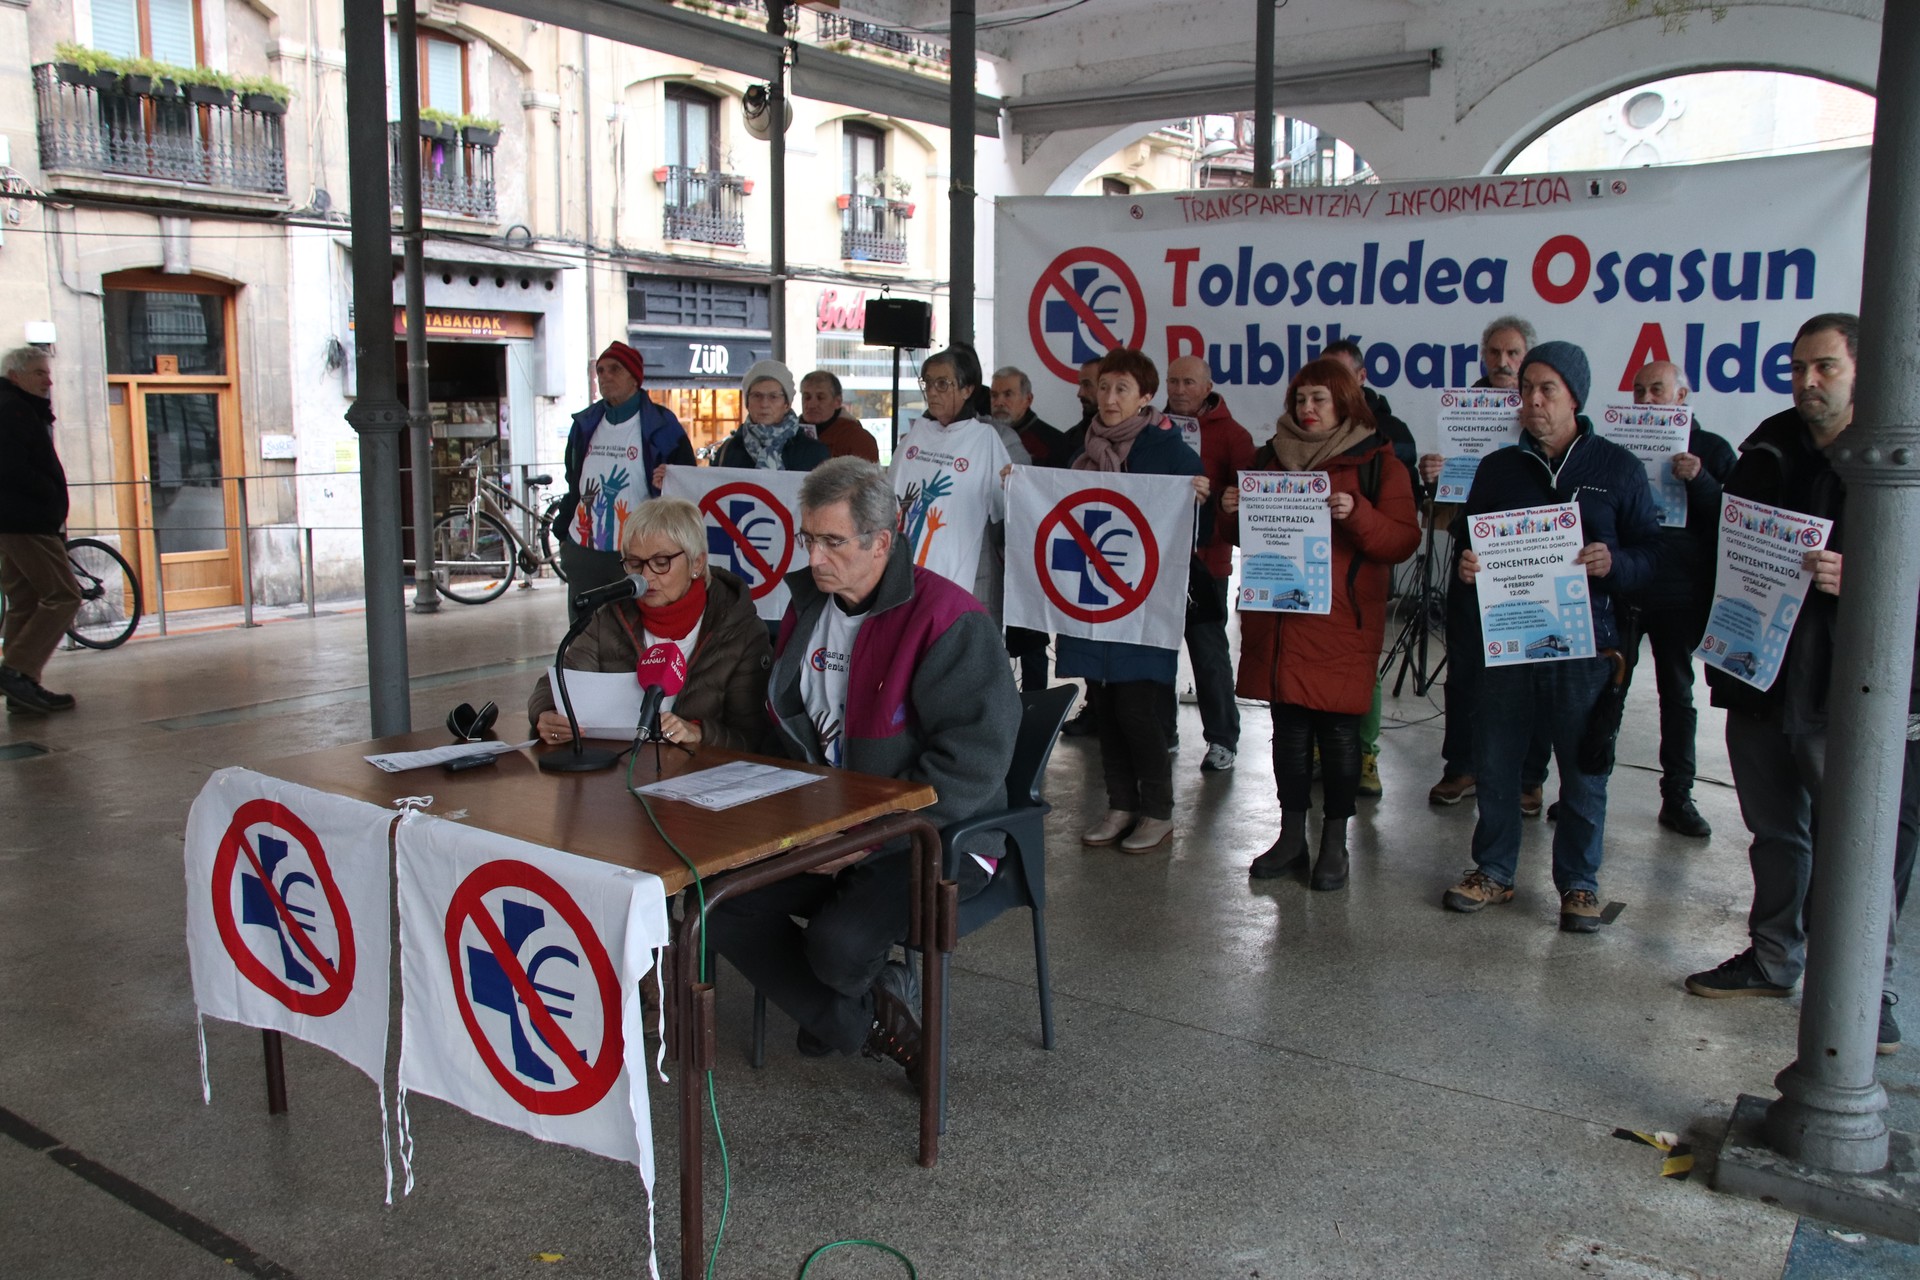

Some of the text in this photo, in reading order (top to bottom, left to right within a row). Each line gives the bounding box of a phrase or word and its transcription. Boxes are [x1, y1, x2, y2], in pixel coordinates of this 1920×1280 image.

[1175, 177, 1571, 223] TRANSPARENTZIA/ INFORMAZIOA
[1164, 234, 1816, 307] Tolosaldea Osasun
[1618, 321, 1793, 394] Alde
[164, 360, 171, 371] 2
[1248, 514, 1315, 523] KONTZENTRAZIOA
[1549, 541, 1578, 549] DONOSTIA
[1486, 553, 1564, 570] CONCENTRACIÓN
[1727, 549, 1800, 580] KONTZENTRAZIOA
[1493, 572, 1543, 583] Hospital Donostia
[1508, 580, 1535, 588] FEBRERO
[1509, 589, 1530, 597] 12:00h
